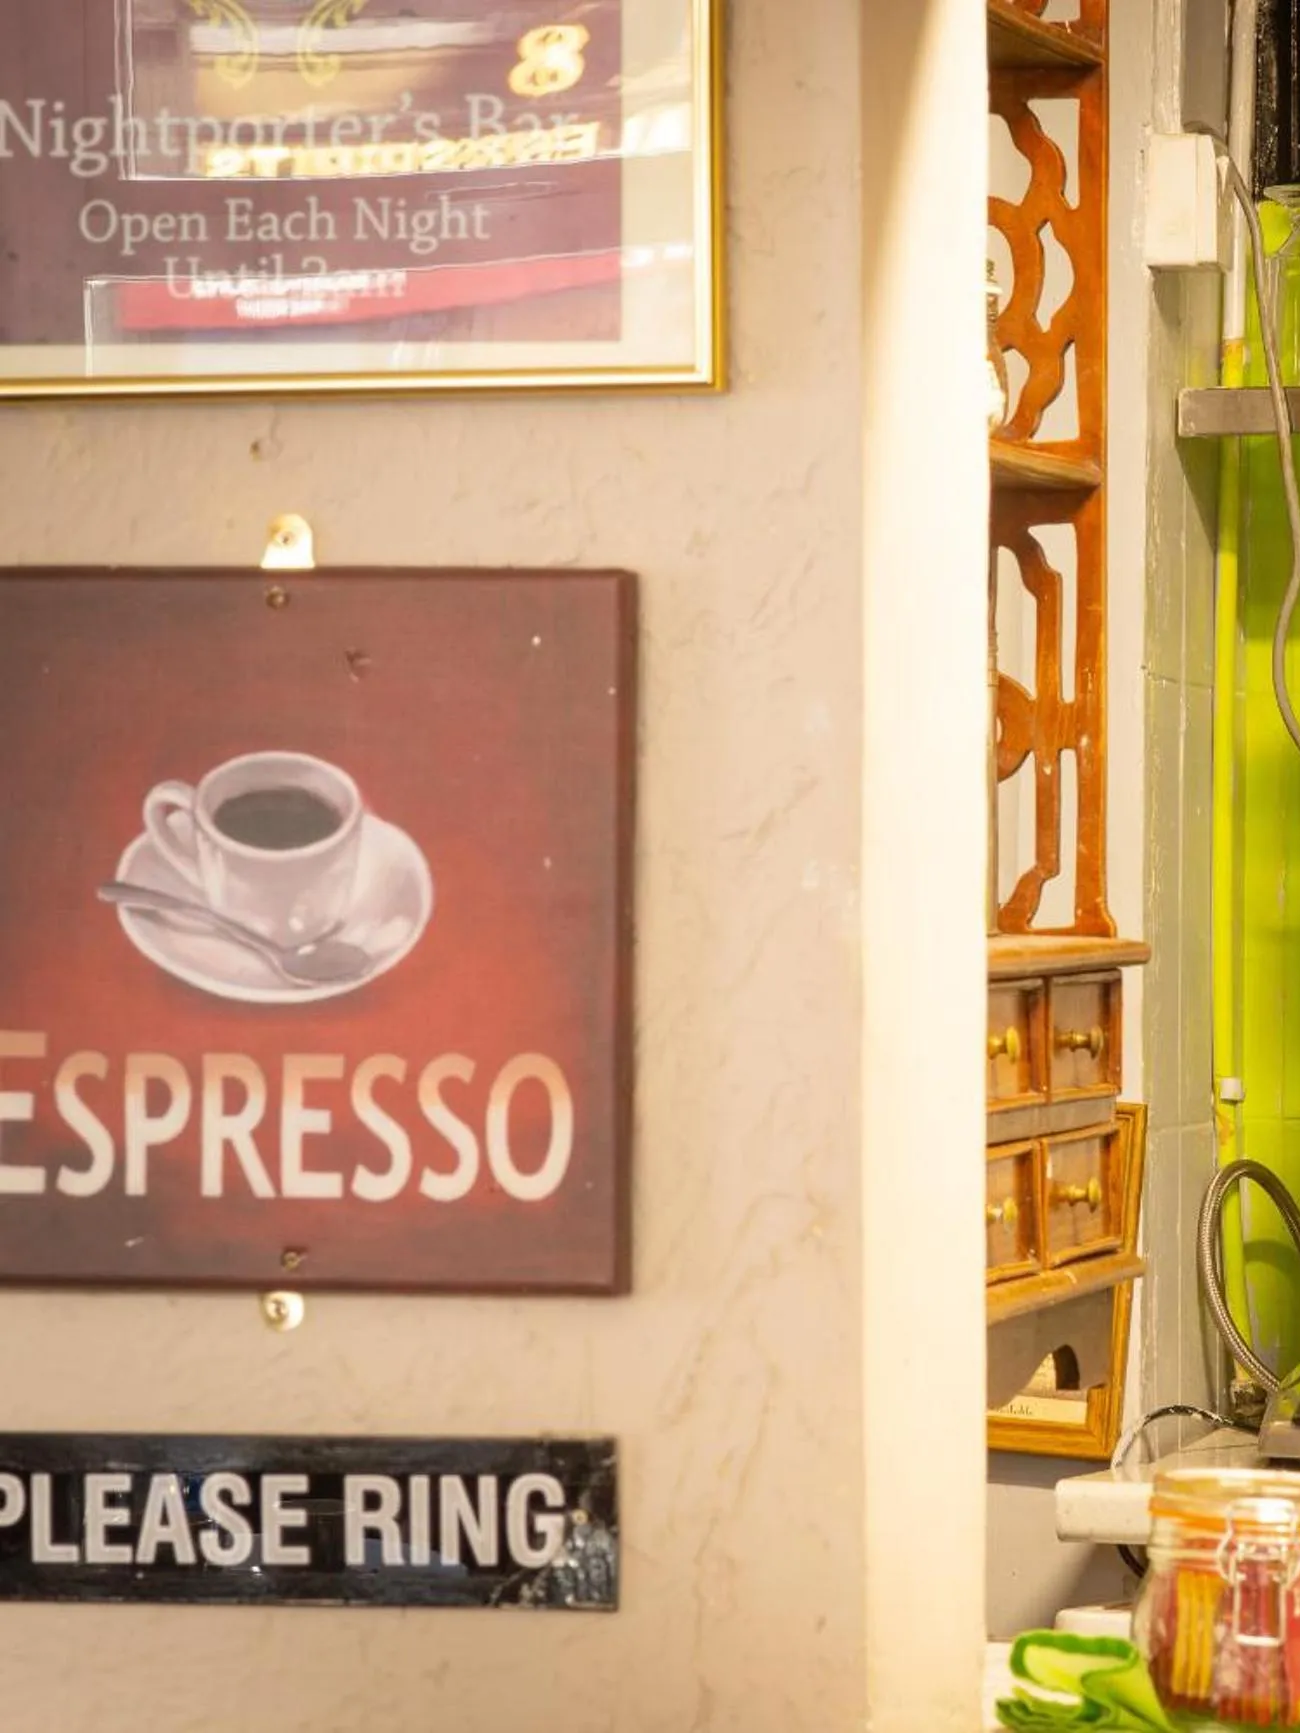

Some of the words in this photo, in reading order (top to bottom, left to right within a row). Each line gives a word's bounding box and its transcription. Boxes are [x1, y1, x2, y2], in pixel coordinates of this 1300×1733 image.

[0, 92, 442, 178] Nightporter's
[78, 199, 209, 256] Open
[225, 196, 338, 243] Each
[353, 195, 491, 255] Night
[0, 1028, 574, 1202] ESPRESSO
[0, 1472, 310, 1567] PLEASE
[343, 1472, 564, 1568] RING
